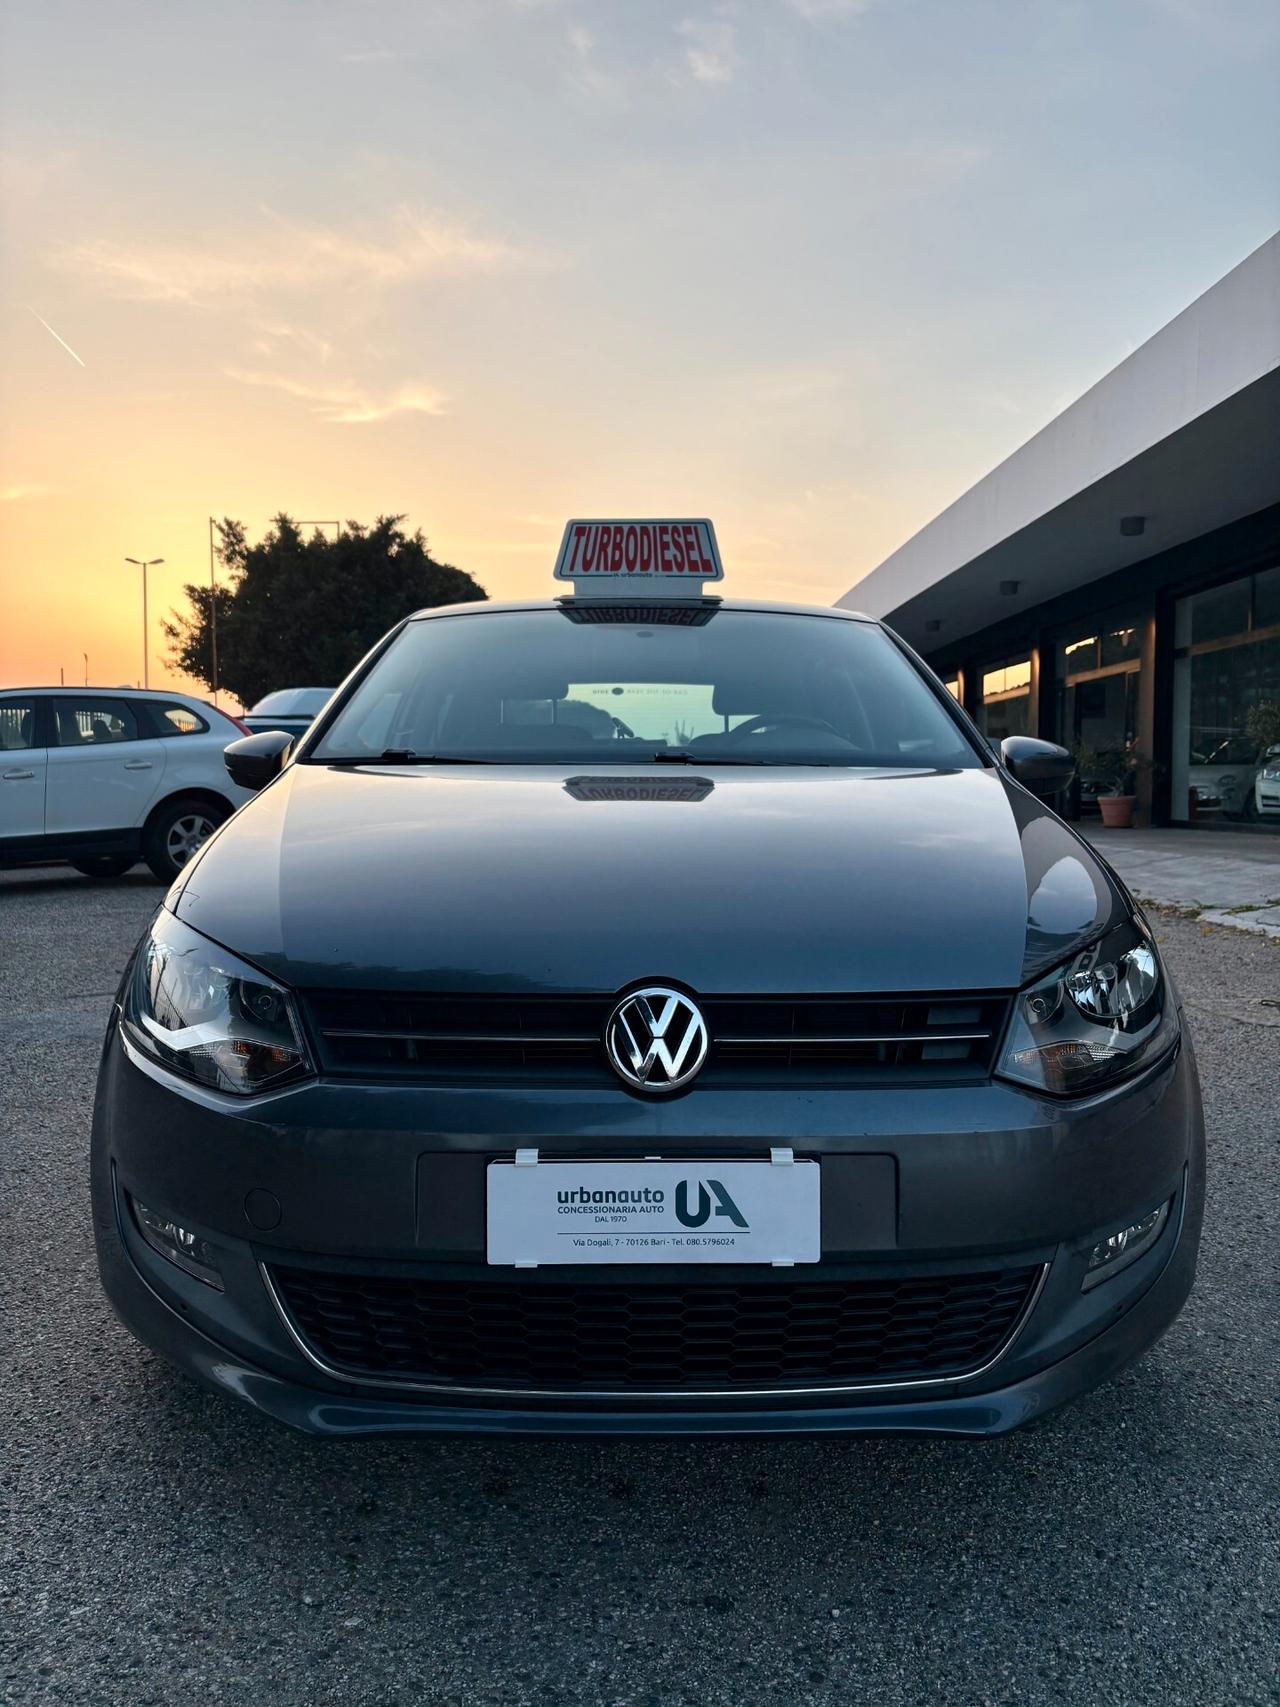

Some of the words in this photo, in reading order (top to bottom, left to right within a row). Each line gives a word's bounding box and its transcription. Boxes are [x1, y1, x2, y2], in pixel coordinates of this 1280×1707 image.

[570, 526, 713, 572] TURBODIESEL
[557, 1186, 665, 1204] urbanauto
[557, 1205, 637, 1215] CONCESSIONARIA
[639, 1205, 665, 1214] AUTO
[675, 1179, 749, 1228] UA
[595, 1215, 609, 1223] DAL
[610, 1215, 628, 1223] 1970
[572, 1239, 586, 1247] Via
[587, 1238, 614, 1248] Dogali,
[615, 1238, 620, 1246] 7
[626, 1238, 649, 1247] 70126
[650, 1238, 666, 1246] Bari
[671, 1238, 685, 1246] Tel.
[686, 1238, 735, 1246] 080.5796024
